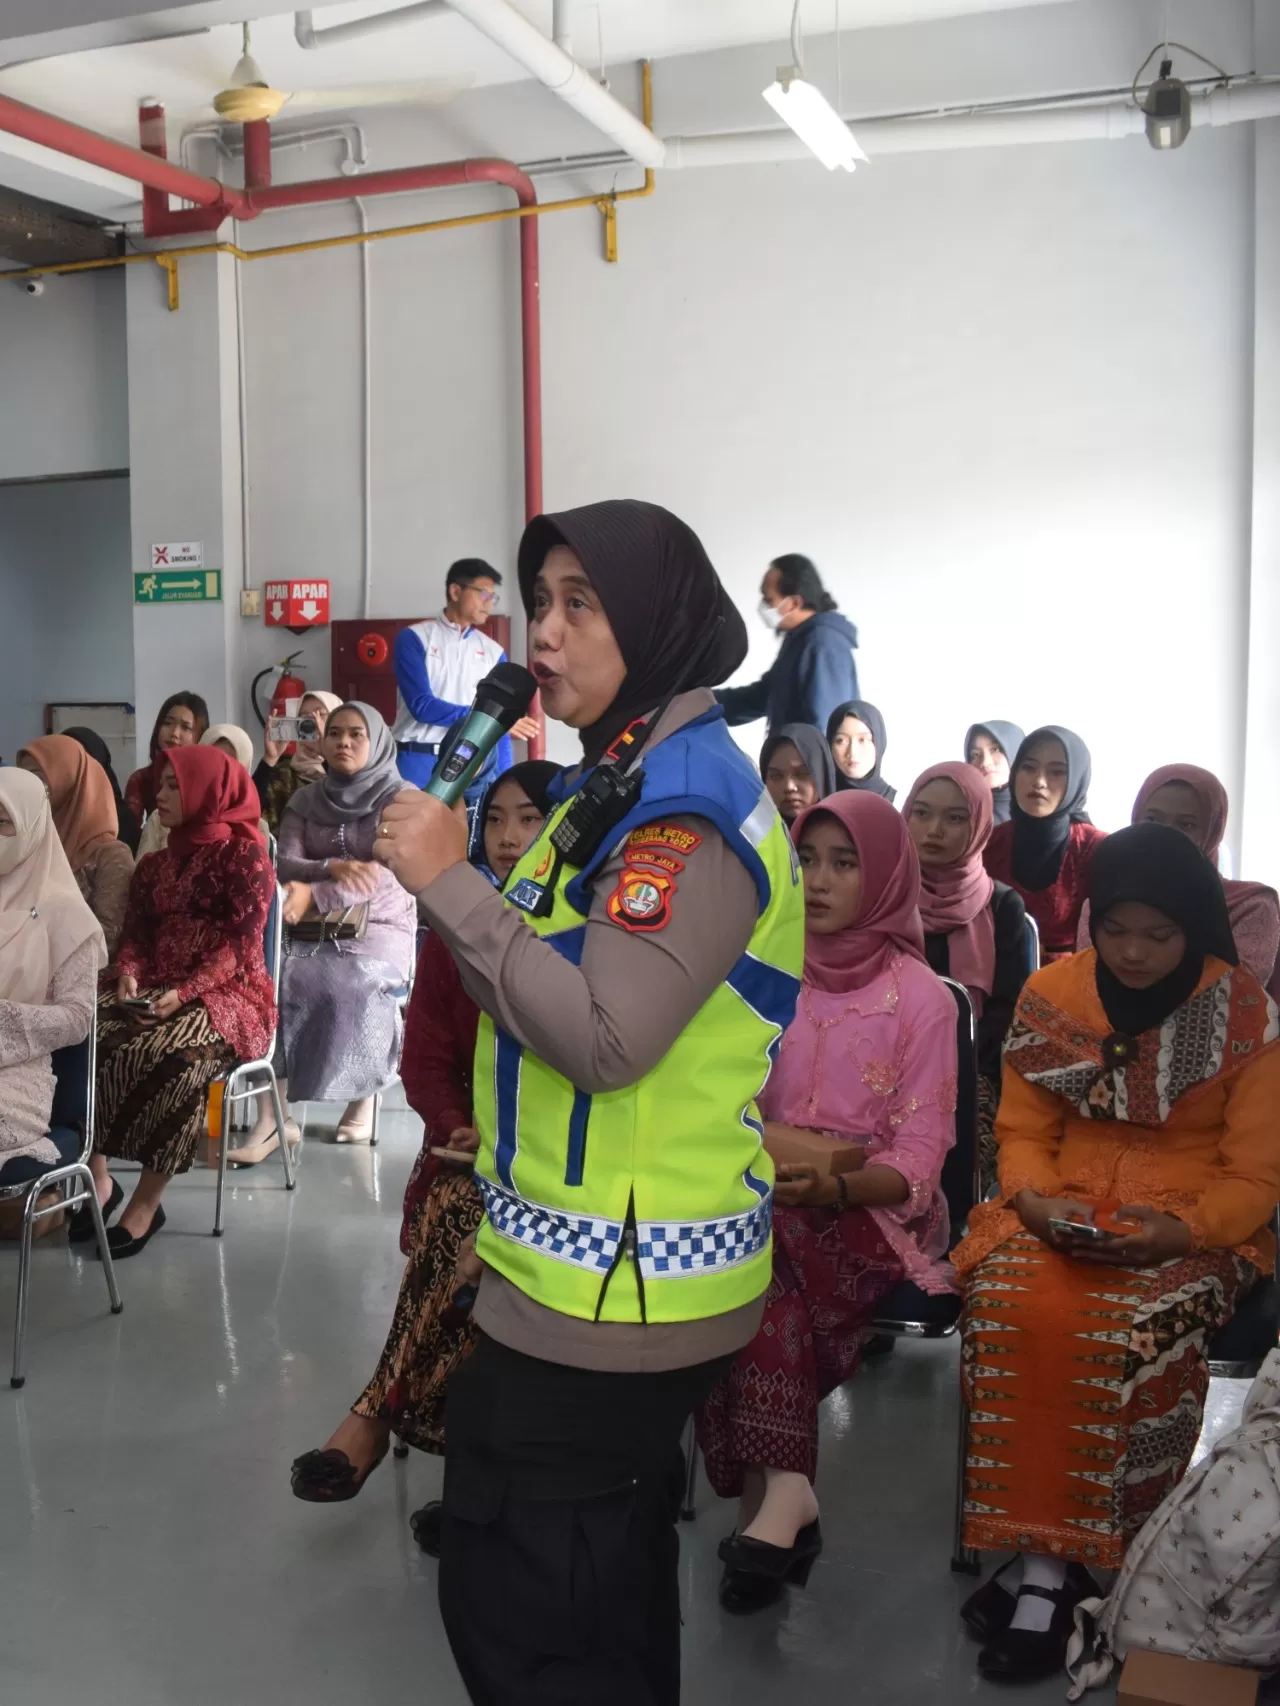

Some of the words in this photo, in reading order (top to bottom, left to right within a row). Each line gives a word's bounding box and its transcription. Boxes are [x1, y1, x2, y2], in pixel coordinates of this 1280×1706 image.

[171, 555, 197, 563] SMOKING
[266, 584, 288, 600] APAR
[292, 583, 328, 600] APAR
[663, 828, 695, 844] METRO
[669, 837, 689, 850] KOTA
[631, 853, 655, 862] METRO
[657, 857, 675, 869] JAYA
